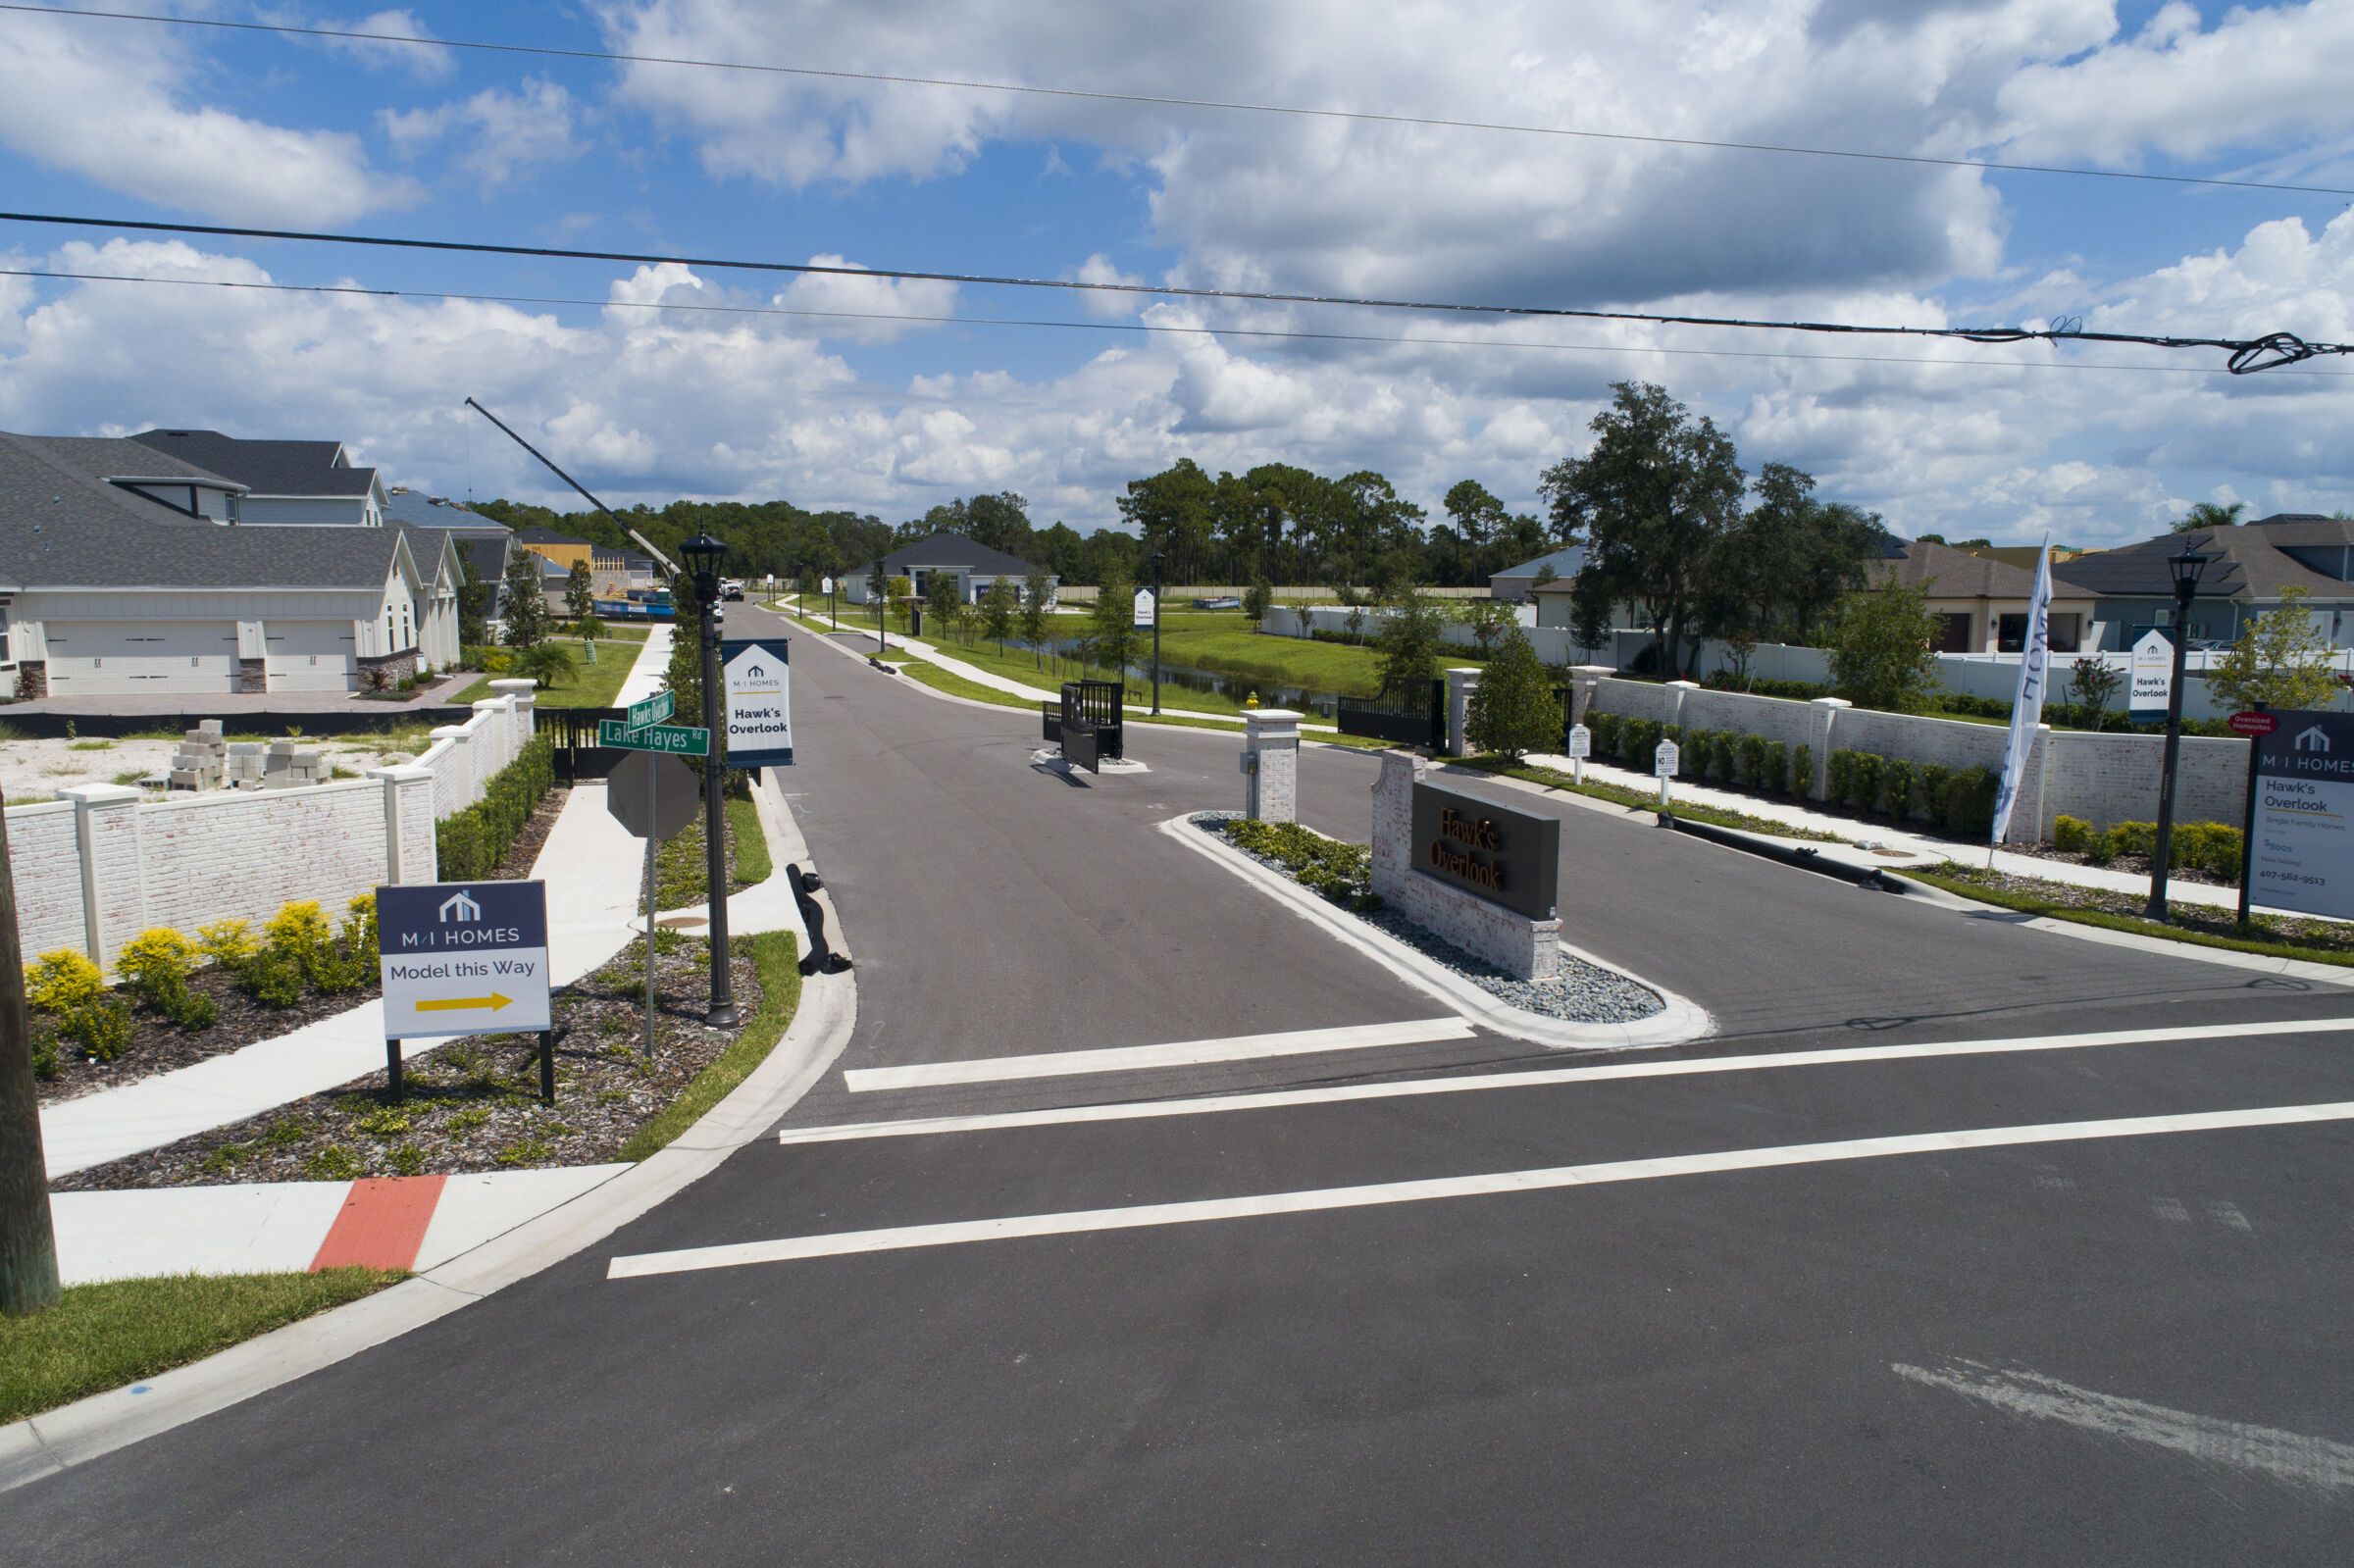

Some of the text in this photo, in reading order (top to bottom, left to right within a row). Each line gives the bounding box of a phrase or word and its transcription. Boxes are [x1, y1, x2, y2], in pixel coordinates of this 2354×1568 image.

[735, 708, 781, 719] Hawk's
[729, 722, 788, 734] Overlook
[606, 722, 702, 751] Lake Hayes Rd
[2266, 780, 2316, 794] Hawk's
[2265, 795, 2328, 812] Overlook
[1440, 807, 1495, 851] Hawk's
[2266, 816, 2346, 832] Single Family Homes
[1428, 840, 1502, 891] Overlook
[2260, 870, 2326, 886] 407-562-9513
[445, 928, 520, 944] HOMES
[390, 960, 536, 980] Model this Way
